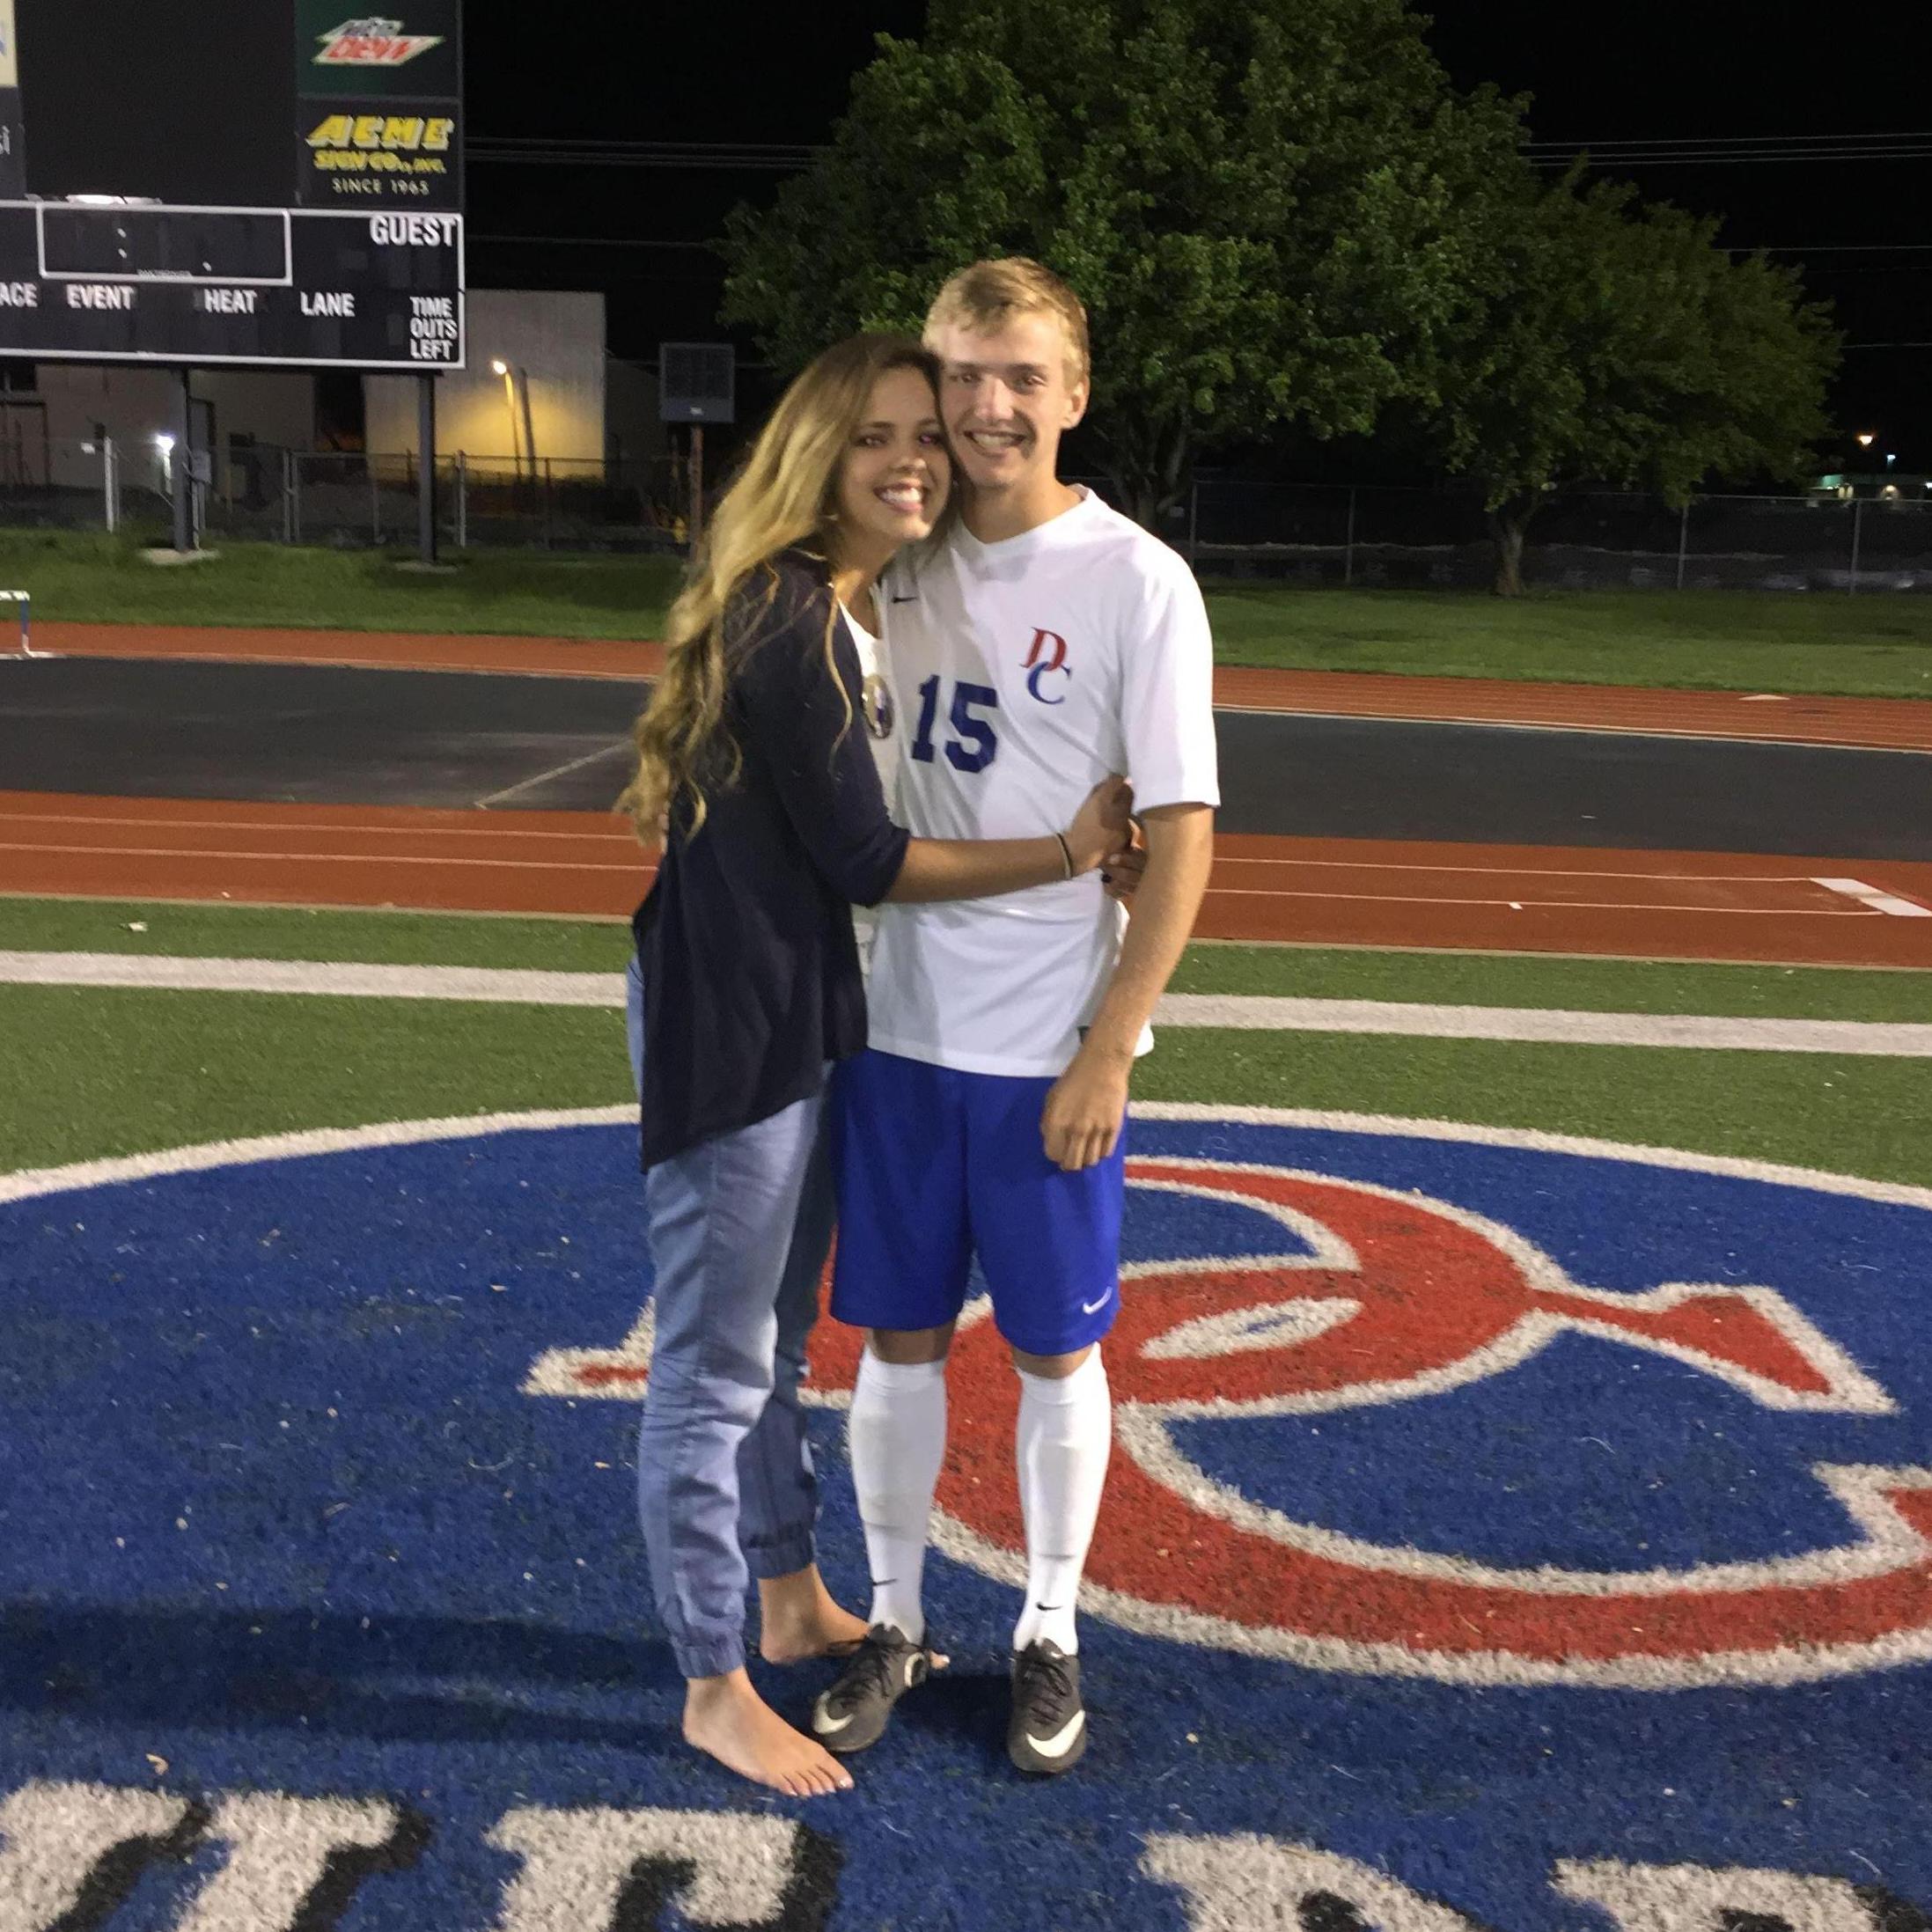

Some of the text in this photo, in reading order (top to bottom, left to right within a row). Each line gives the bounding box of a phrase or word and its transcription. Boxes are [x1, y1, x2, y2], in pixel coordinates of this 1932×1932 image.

[305, 114, 455, 151] ACME
[332, 178, 430, 195] SINCE 1965
[369, 215, 457, 247] GUEST
[66, 283, 134, 310] EVENT
[203, 288, 257, 314] HEAT
[300, 291, 356, 317] LANE
[409, 297, 453, 318] TIME
[409, 317, 458, 340] OUTS
[409, 338, 453, 360] LEFT
[911, 674, 998, 774] 15
